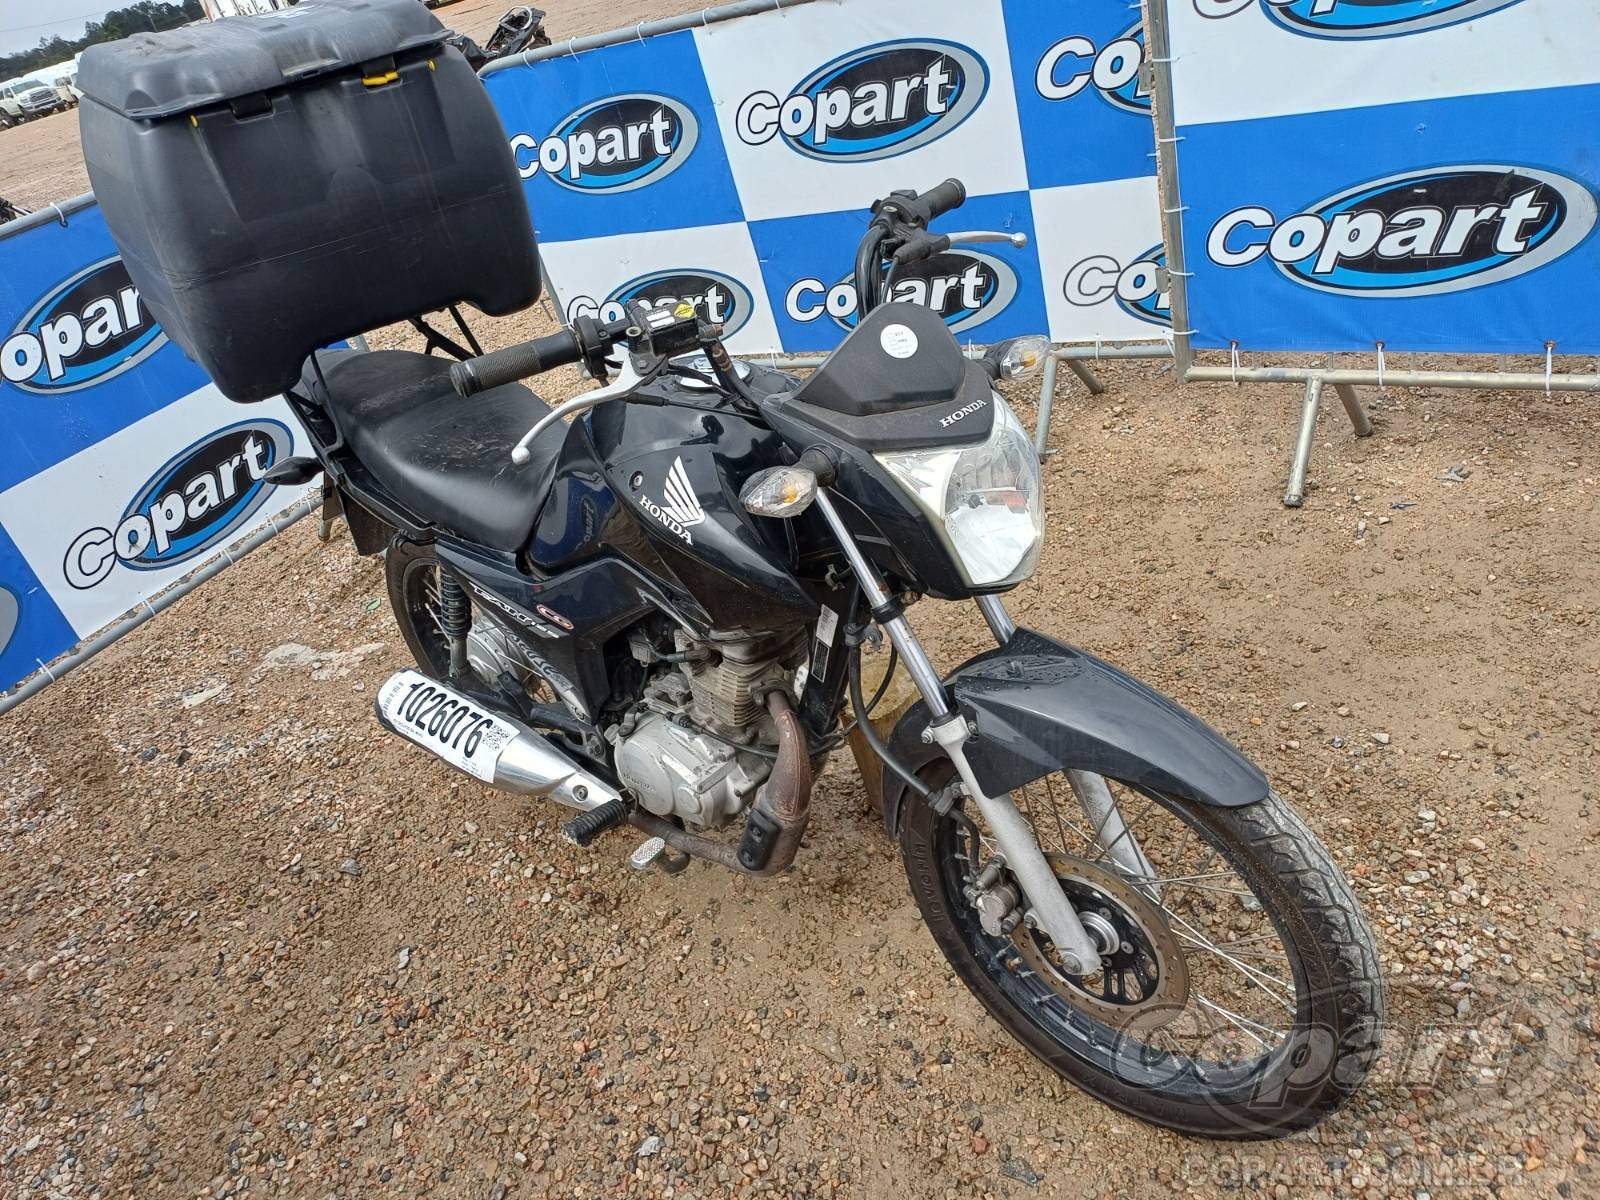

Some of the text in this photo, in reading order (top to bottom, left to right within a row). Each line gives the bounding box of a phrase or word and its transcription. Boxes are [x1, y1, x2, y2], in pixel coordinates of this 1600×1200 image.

[735, 55, 952, 146] Copart
[1034, 34, 1151, 101] Co
[510, 105, 674, 181] Copart
[1204, 182, 1550, 277] Copart
[567, 281, 727, 326] Cort
[784, 260, 986, 323] Coart
[1062, 254, 1170, 308] Co
[936, 398, 988, 429] HONDA
[63, 428, 269, 591] Copart
[639, 493, 695, 547] HONDA
[396, 681, 495, 759] 1026076
